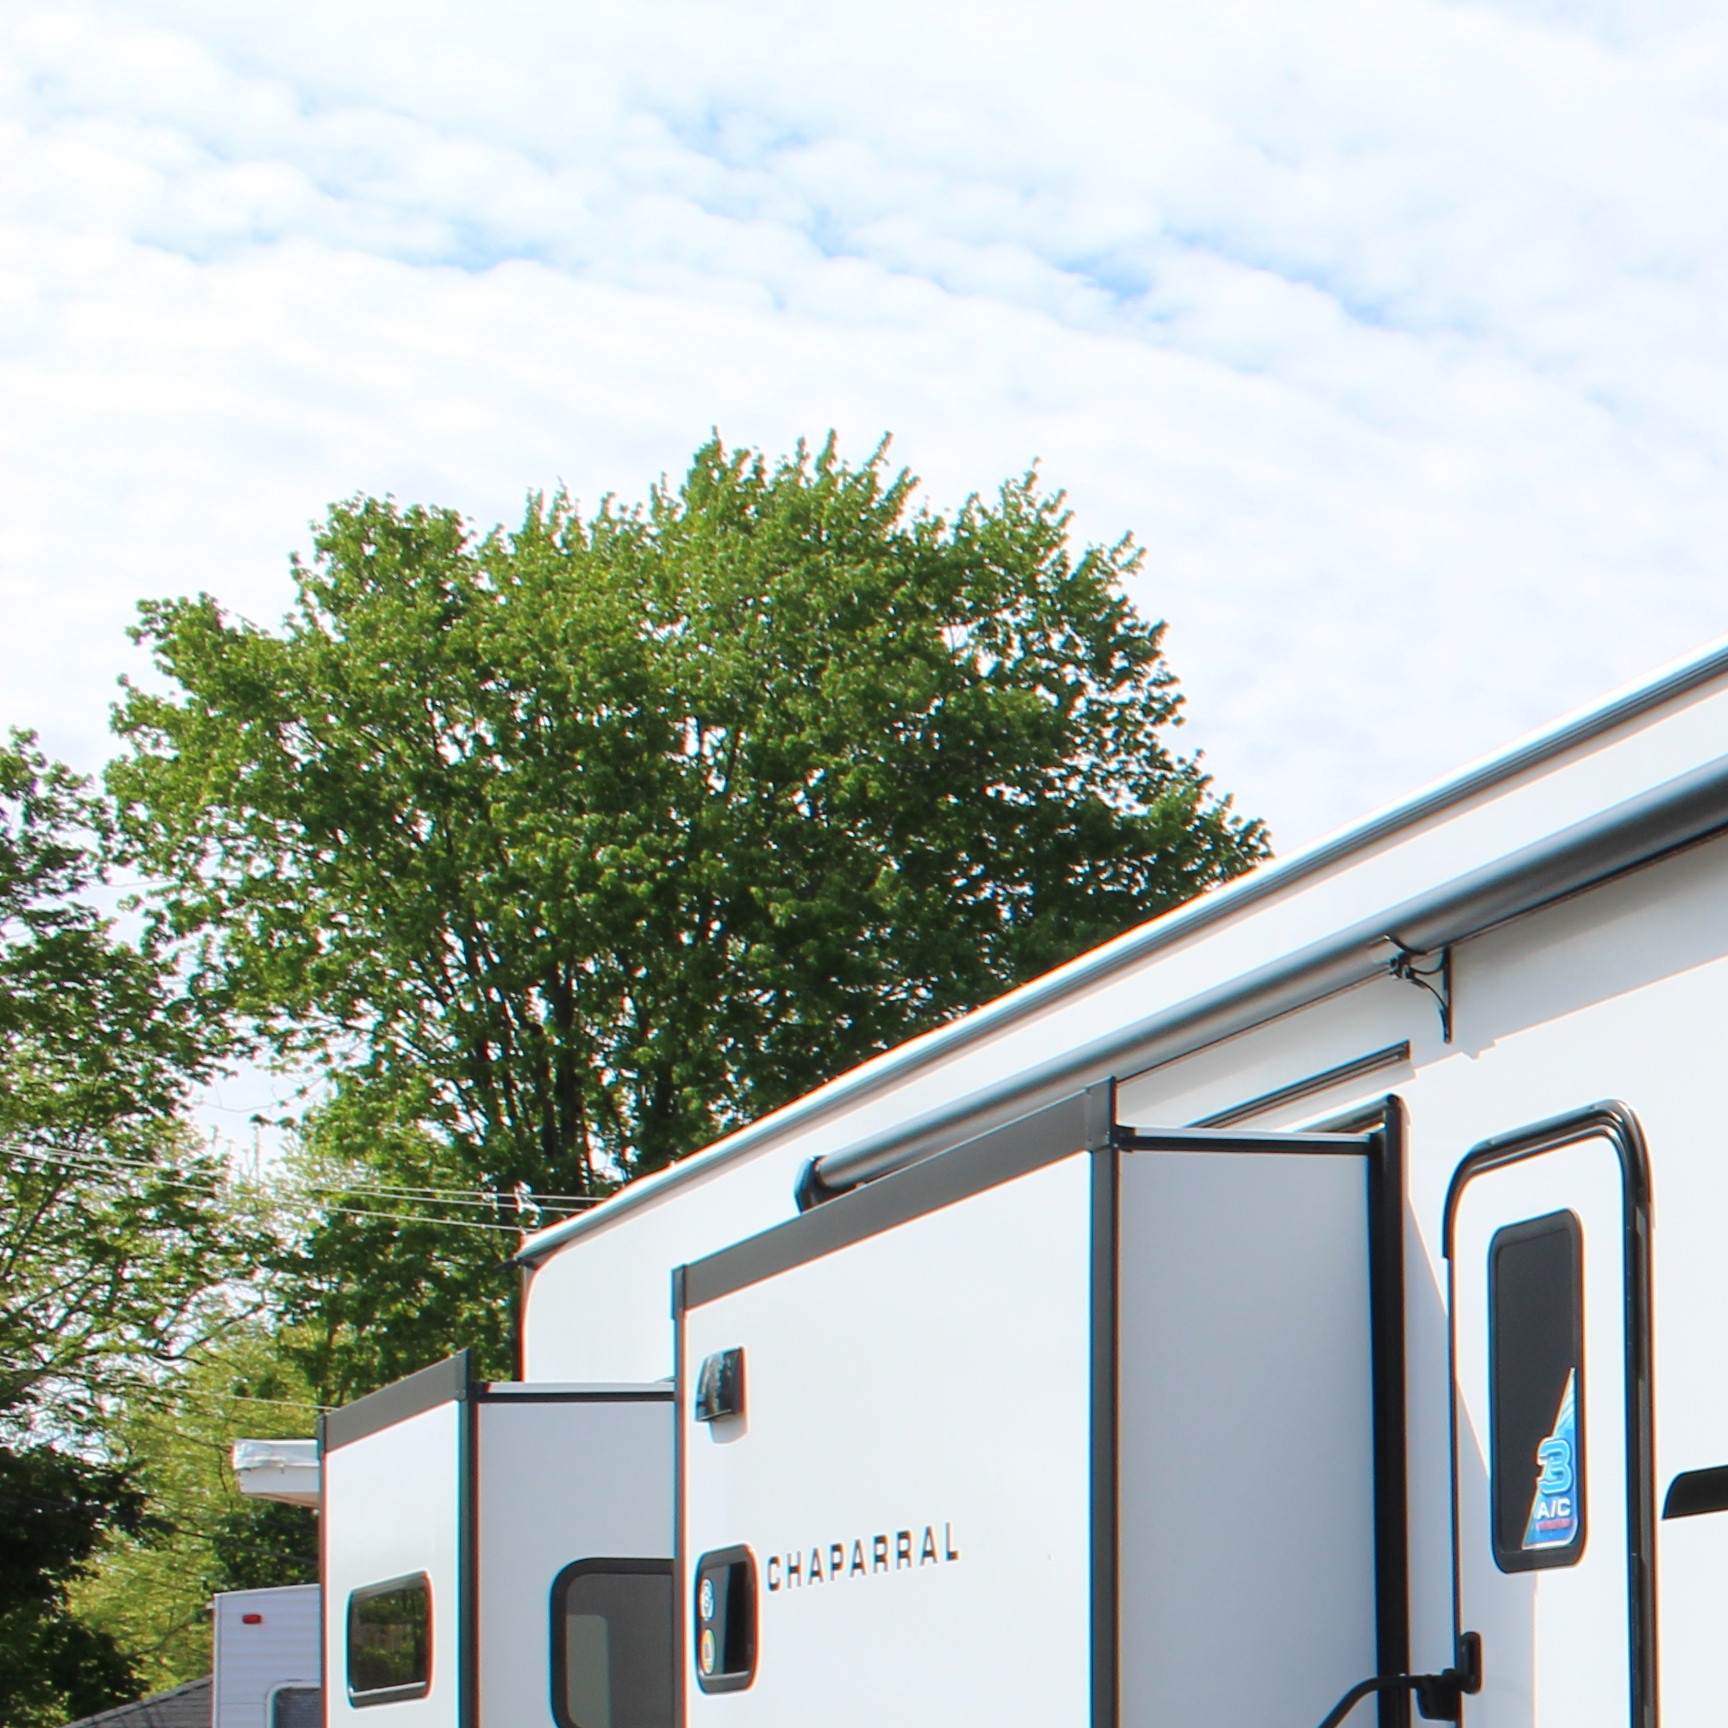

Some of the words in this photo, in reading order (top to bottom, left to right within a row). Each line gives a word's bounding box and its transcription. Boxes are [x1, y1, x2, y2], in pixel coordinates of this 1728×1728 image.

[1538, 1438, 1573, 1494] 3
[1535, 1498, 1571, 1520] A/C
[767, 1522, 961, 1592] CHAPARRAL
